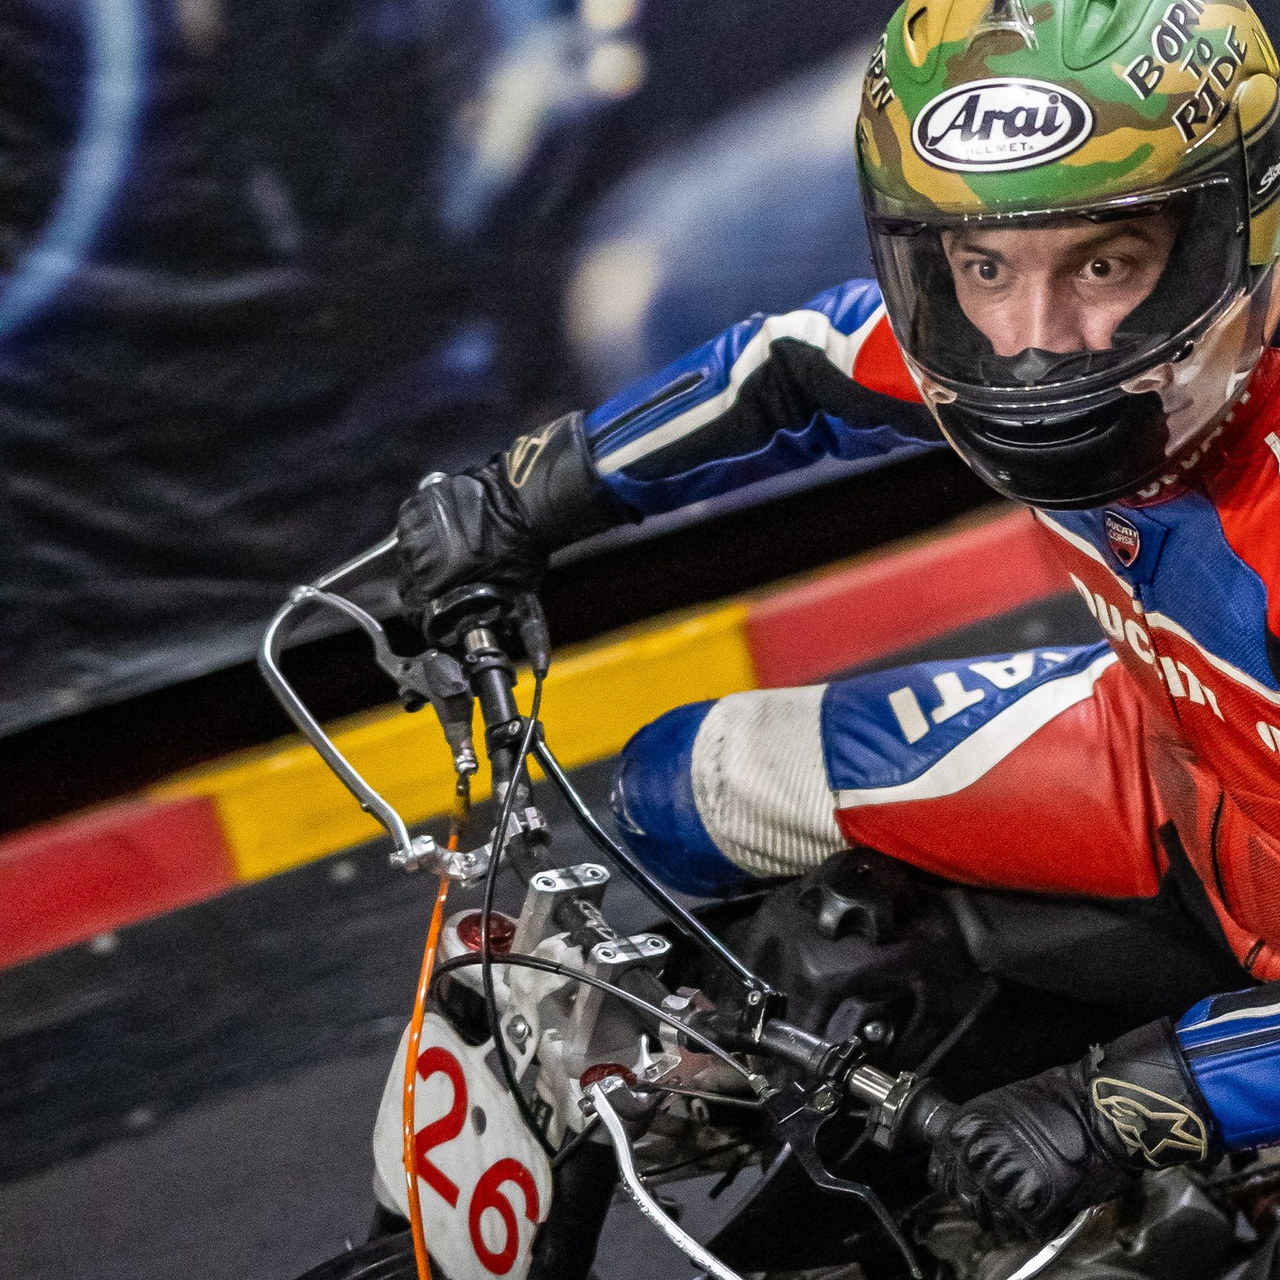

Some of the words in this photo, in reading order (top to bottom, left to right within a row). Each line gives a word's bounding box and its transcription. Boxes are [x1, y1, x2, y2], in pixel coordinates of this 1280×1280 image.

[1179, 36, 1213, 81] TO
[1171, 25, 1247, 144] RIDE
[926, 93, 1064, 147] Arai
[1106, 517, 1137, 538] DUCATI
[1109, 529, 1135, 546] CORSE
[414, 1046, 541, 1276] 26
